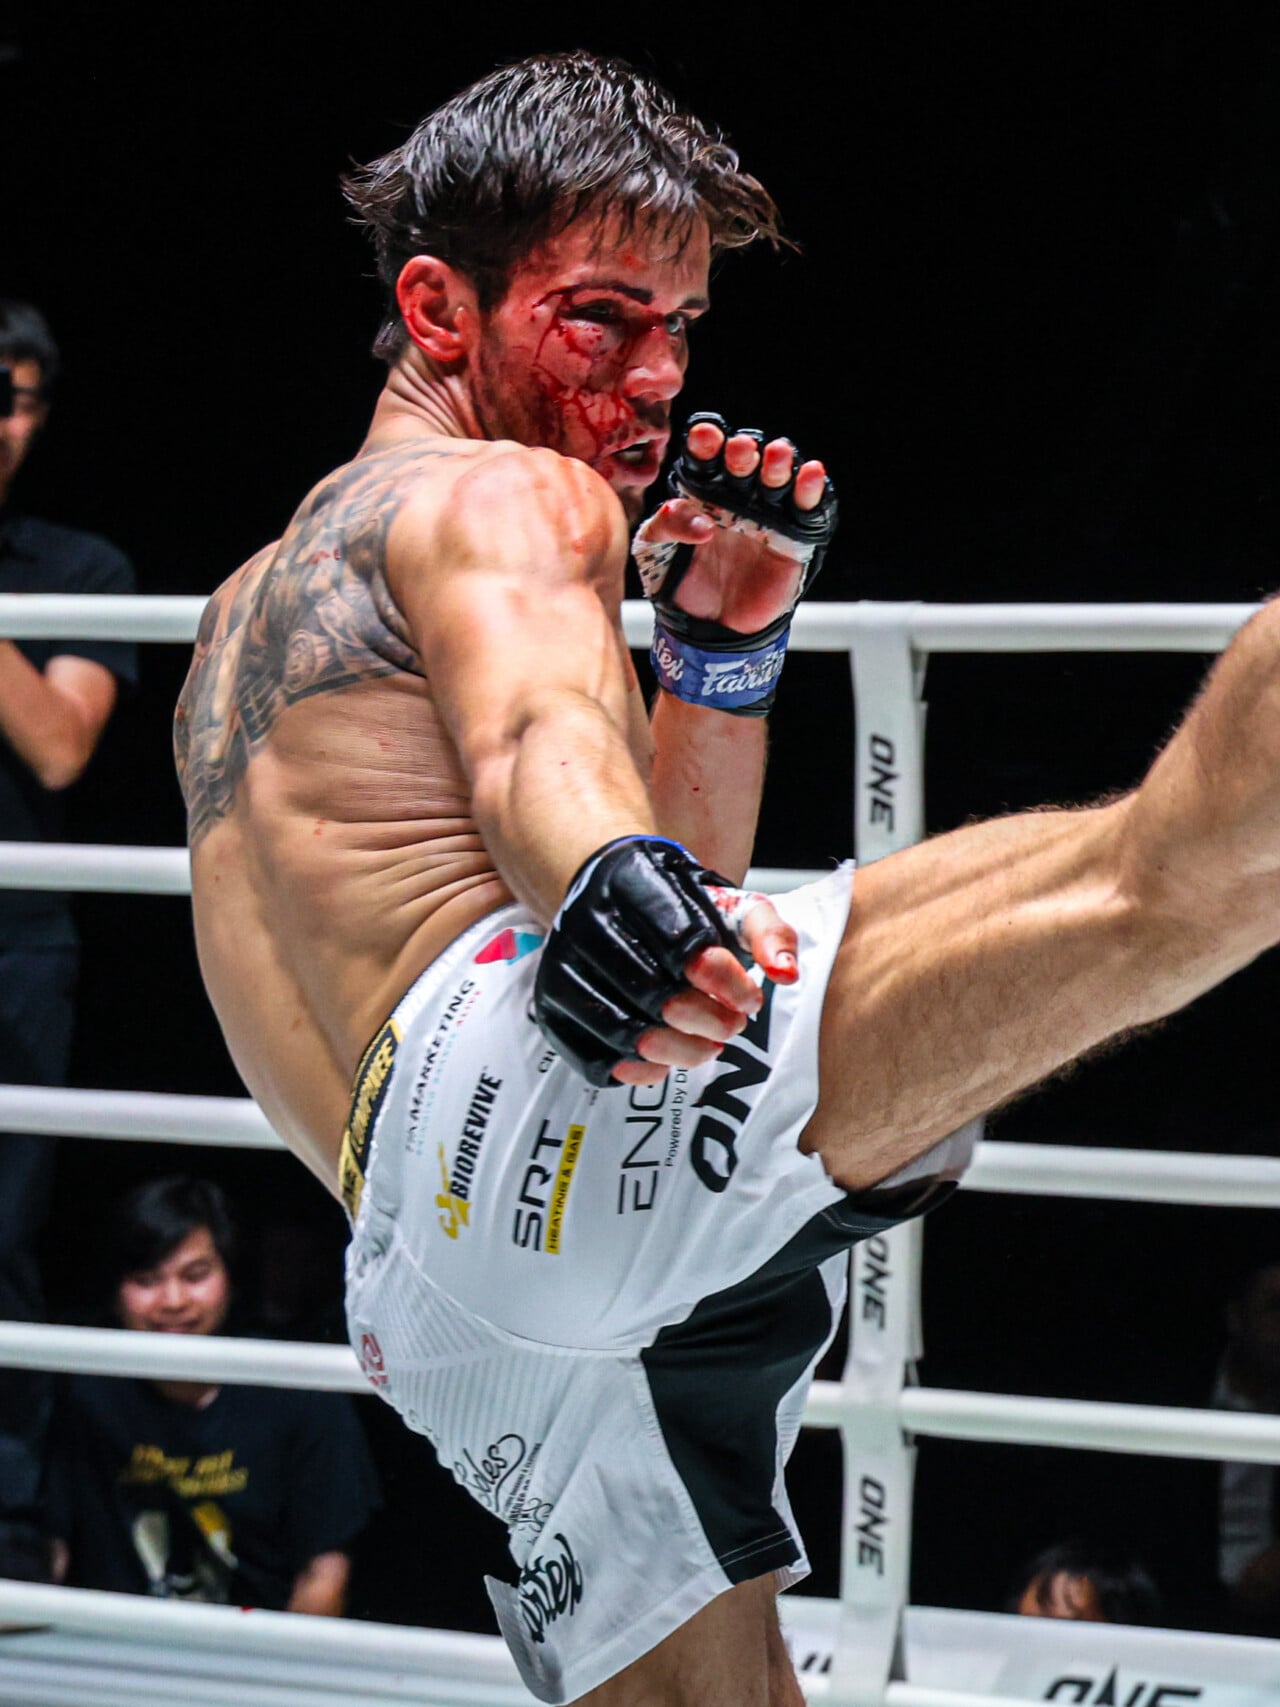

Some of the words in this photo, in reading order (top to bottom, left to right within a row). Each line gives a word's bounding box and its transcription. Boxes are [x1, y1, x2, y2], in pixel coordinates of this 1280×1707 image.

[868, 733, 899, 833] ONE
[450, 1071, 504, 1202] BIOREVIVE
[617, 1074, 669, 1215] ENG
[664, 1107, 682, 1168] Powered
[672, 1087, 688, 1105] by
[512, 1119, 565, 1252] SRT
[560, 1166, 572, 1178] &
[565, 1129, 583, 1164] GAS
[548, 1178, 572, 1249] HEATING
[861, 1235, 891, 1332] ONE
[856, 1476, 888, 1577] ONE
